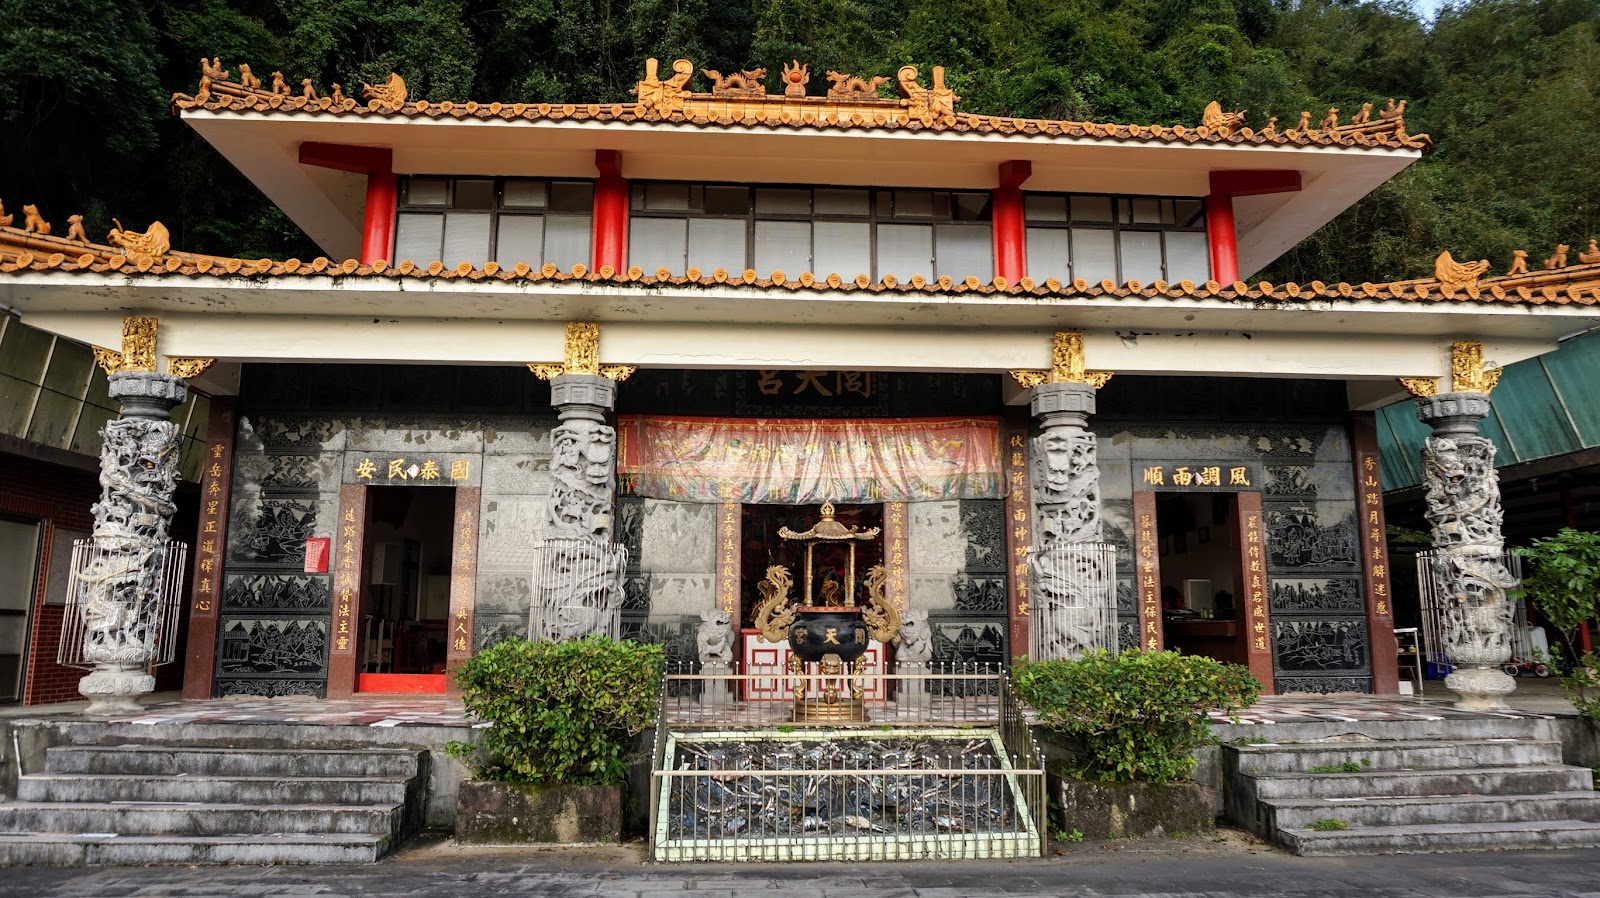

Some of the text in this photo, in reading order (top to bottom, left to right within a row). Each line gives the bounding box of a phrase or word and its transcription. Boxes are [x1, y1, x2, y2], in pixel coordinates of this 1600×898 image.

[355, 458, 470, 480] 國泰民安
[1143, 466, 1250, 486] 風調雨順
